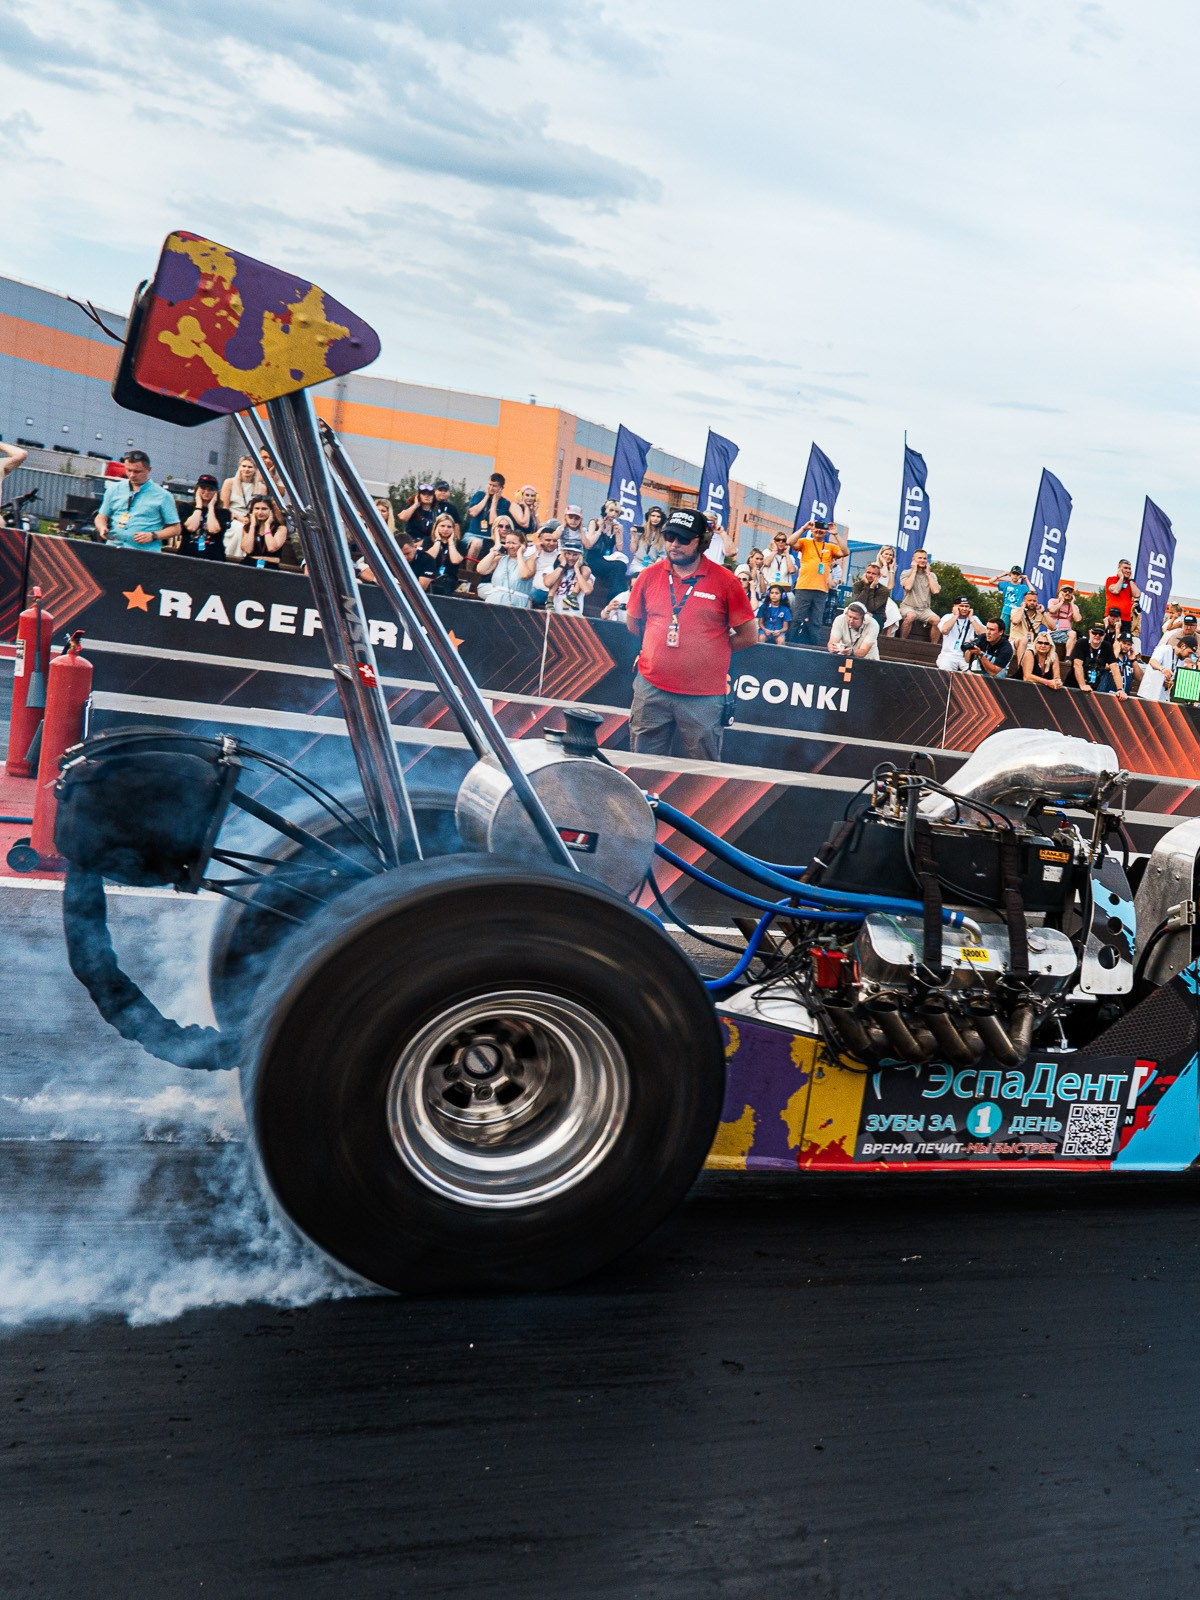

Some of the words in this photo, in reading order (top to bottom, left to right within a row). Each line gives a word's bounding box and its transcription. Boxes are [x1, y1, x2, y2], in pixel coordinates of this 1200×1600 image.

[903, 485, 924, 531] ВТБ
[1038, 525, 1062, 572] ВТБ
[1145, 551, 1167, 596] ВТБ
[922, 1062, 1129, 1108] ЭспаДент
[865, 1114, 926, 1132] ЗУБЫ
[928, 1114, 957, 1132] ЗА
[974, 1105, 992, 1135] 1
[1007, 1115, 1063, 1135] ДЕНЬ
[861, 1143, 913, 1155] ВРЕМЯ
[992, 1142, 1058, 1155] БЫСТРЕЕ
